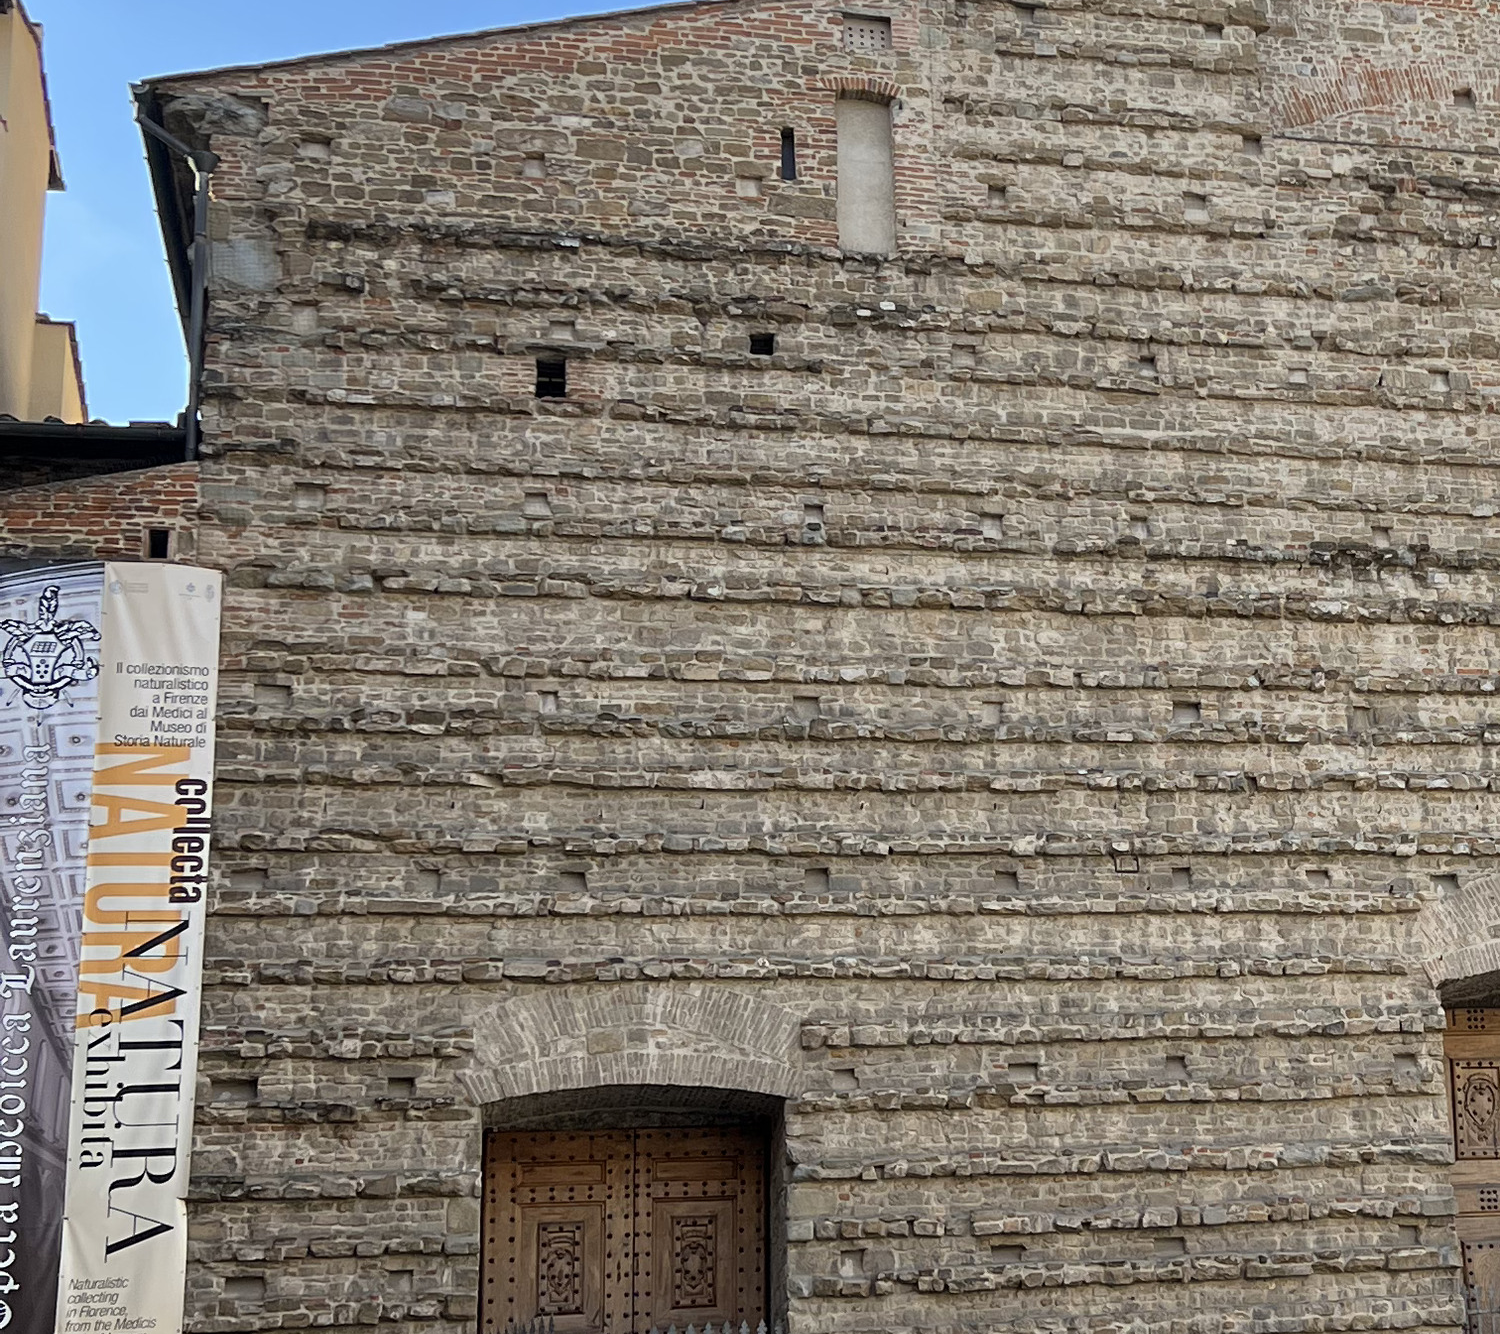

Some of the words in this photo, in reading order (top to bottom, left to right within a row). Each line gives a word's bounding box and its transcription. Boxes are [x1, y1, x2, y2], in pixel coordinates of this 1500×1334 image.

[116, 662, 123, 674] Il
[126, 663, 209, 676] collezionismo
[134, 678, 209, 691] naturalistico
[152, 694, 160, 704] a
[164, 692, 208, 705] Firenze
[130, 706, 148, 718] dai
[152, 707, 193, 719] Medici
[196, 707, 207, 719] al
[150, 721, 192, 733] Museo
[195, 721, 207, 734] di
[114, 734, 150, 747] Storia
[153, 735, 206, 748] Naturale
[168, 778, 211, 904] collecta
[0, 743, 51, 998] Laurenziana
[79, 1007, 126, 1170] exhibita
[104, 910, 190, 1264] NATURA
[68, 1277, 129, 1290] Naturalistic
[67, 1292, 119, 1305] collecting
[66, 1308, 77, 1318] in
[64, 1320, 90, 1333] from
[93, 1320, 111, 1331] the
[114, 1317, 157, 1331] Medicis
